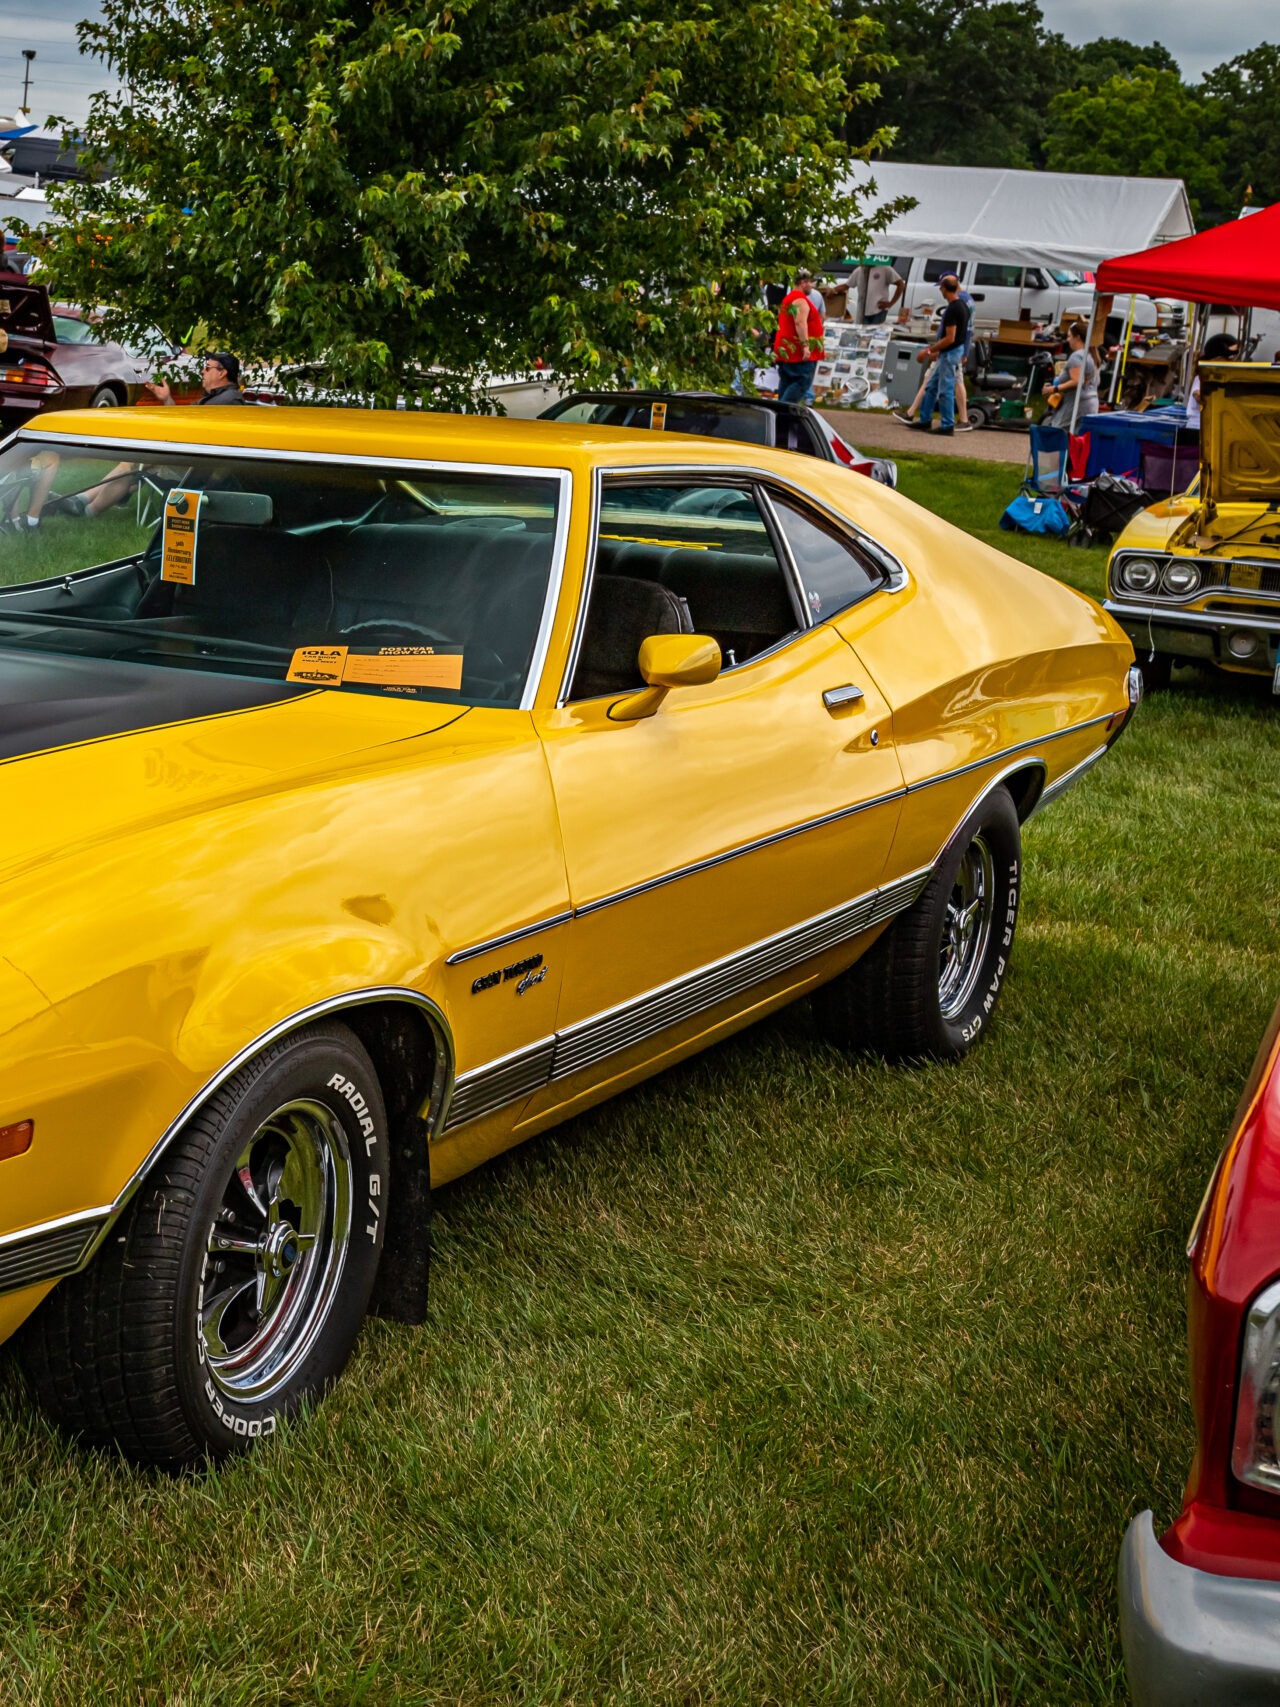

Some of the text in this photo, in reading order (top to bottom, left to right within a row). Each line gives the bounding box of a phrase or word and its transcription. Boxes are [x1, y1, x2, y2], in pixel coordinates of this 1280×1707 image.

[961, 860, 1018, 1042] TIGER PAW GTS
[326, 1073, 381, 1245] RADIAL G/T
[205, 1378, 276, 1437] COOPER
